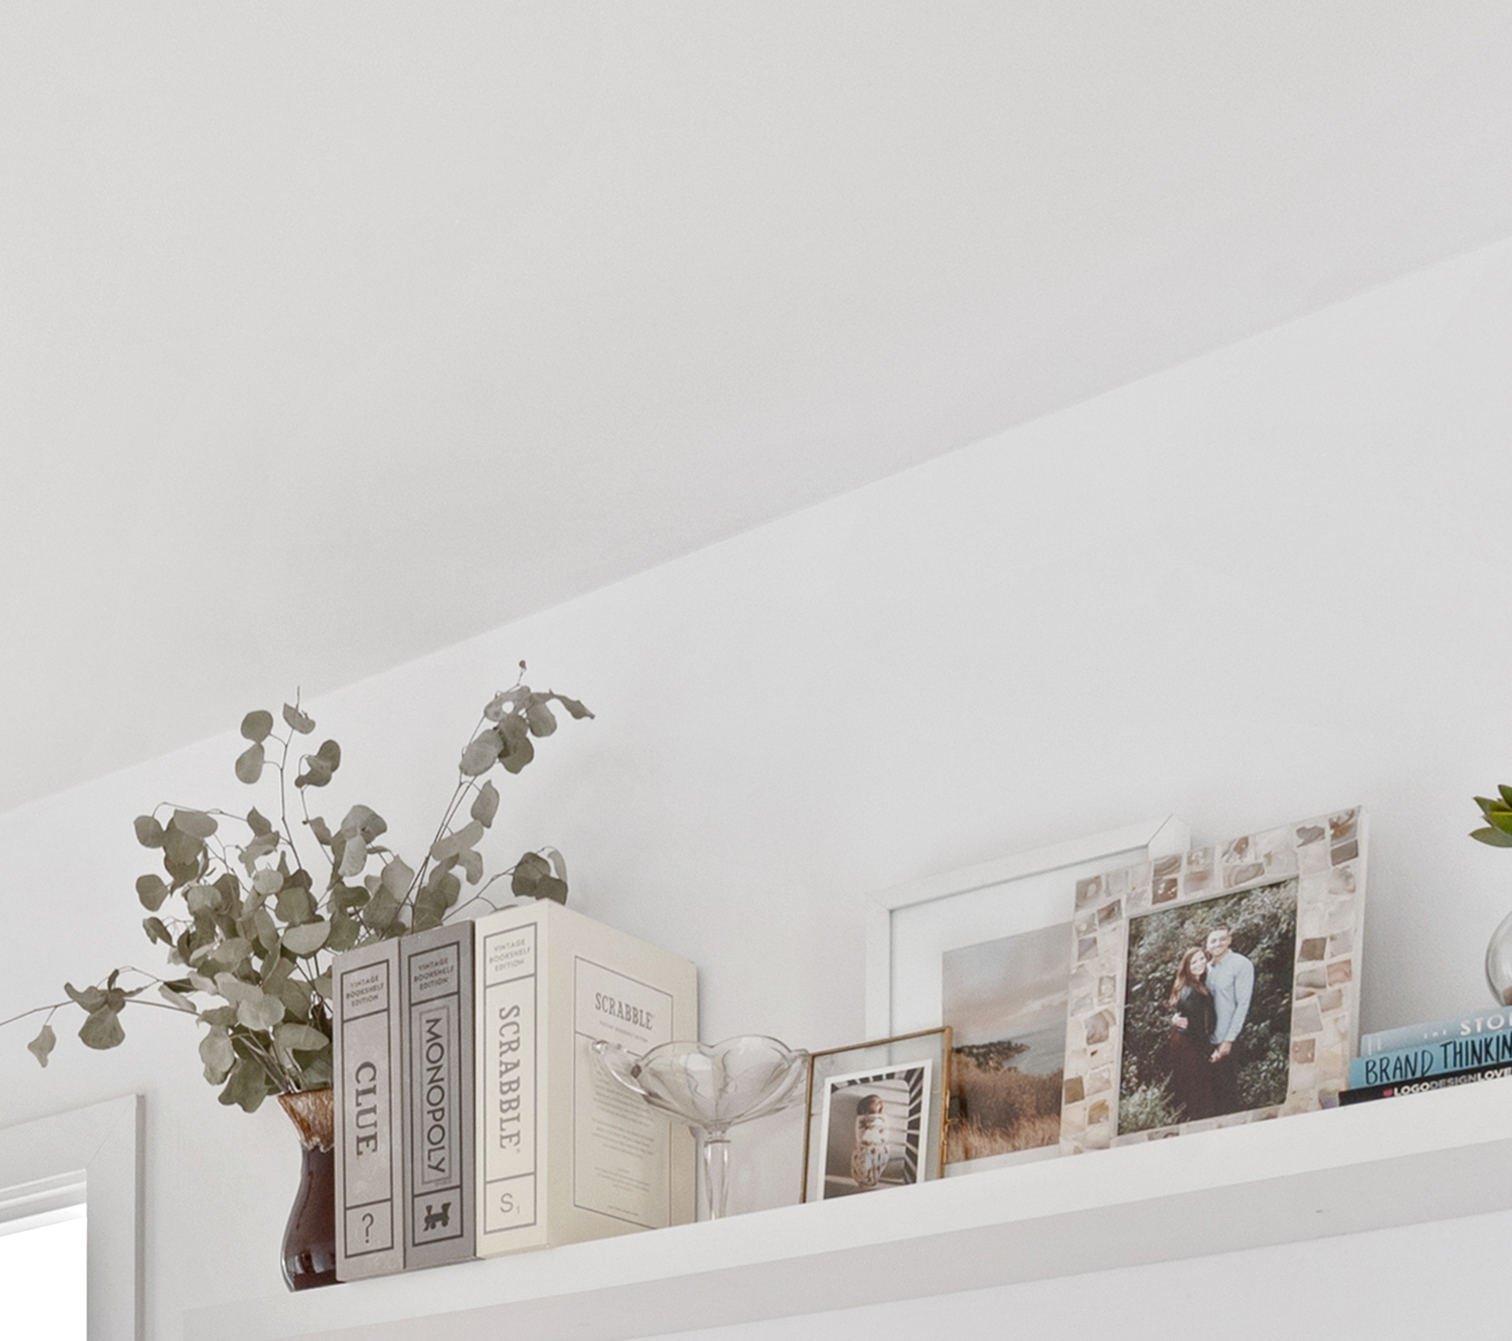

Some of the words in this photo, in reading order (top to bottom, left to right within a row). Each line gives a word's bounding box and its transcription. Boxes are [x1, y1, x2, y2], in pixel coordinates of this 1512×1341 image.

[594, 992, 653, 1031] SCRABBLE
[355, 1061, 378, 1157] CLUE
[425, 1017, 446, 1173] MONOPOLY
[498, 1004, 521, 1150] SCRABBLE
[1364, 1048, 1434, 1085] BRAND
